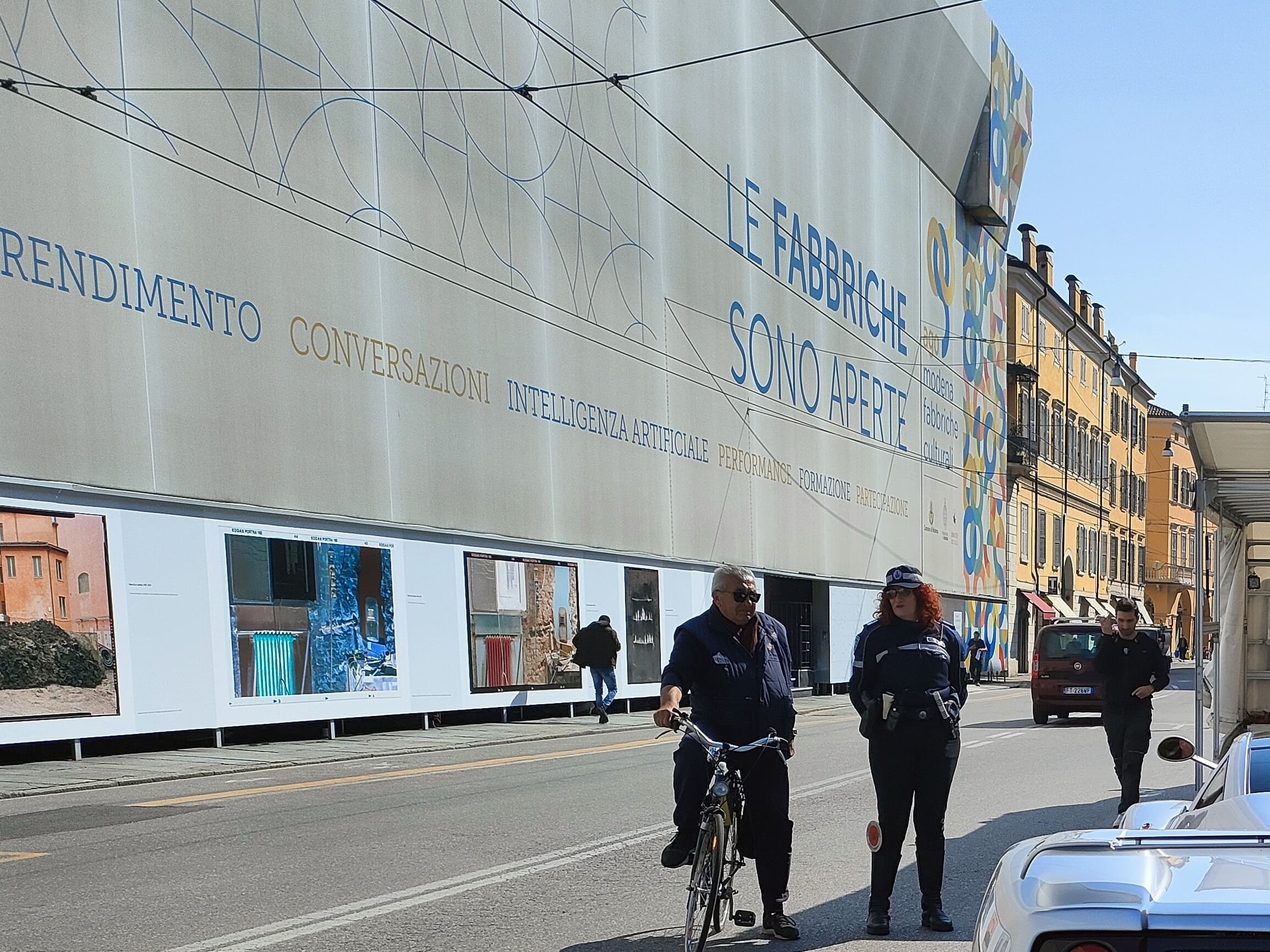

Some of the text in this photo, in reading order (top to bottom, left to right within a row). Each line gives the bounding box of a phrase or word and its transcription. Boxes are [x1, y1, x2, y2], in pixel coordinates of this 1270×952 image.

[727, 164, 907, 356] LE FABBRICHE
[0, 227, 909, 518] RENDIMENTO CONVERSAZIONI INTELLIGENZA ARTIFICIALE PERFORMANCE FORMAZIONE PARTECIPAZIONE
[730, 301, 907, 451] SONO APERTE
[923, 367, 954, 401] modena
[923, 397, 958, 439] fabbriche
[923, 438, 954, 470] culturali
